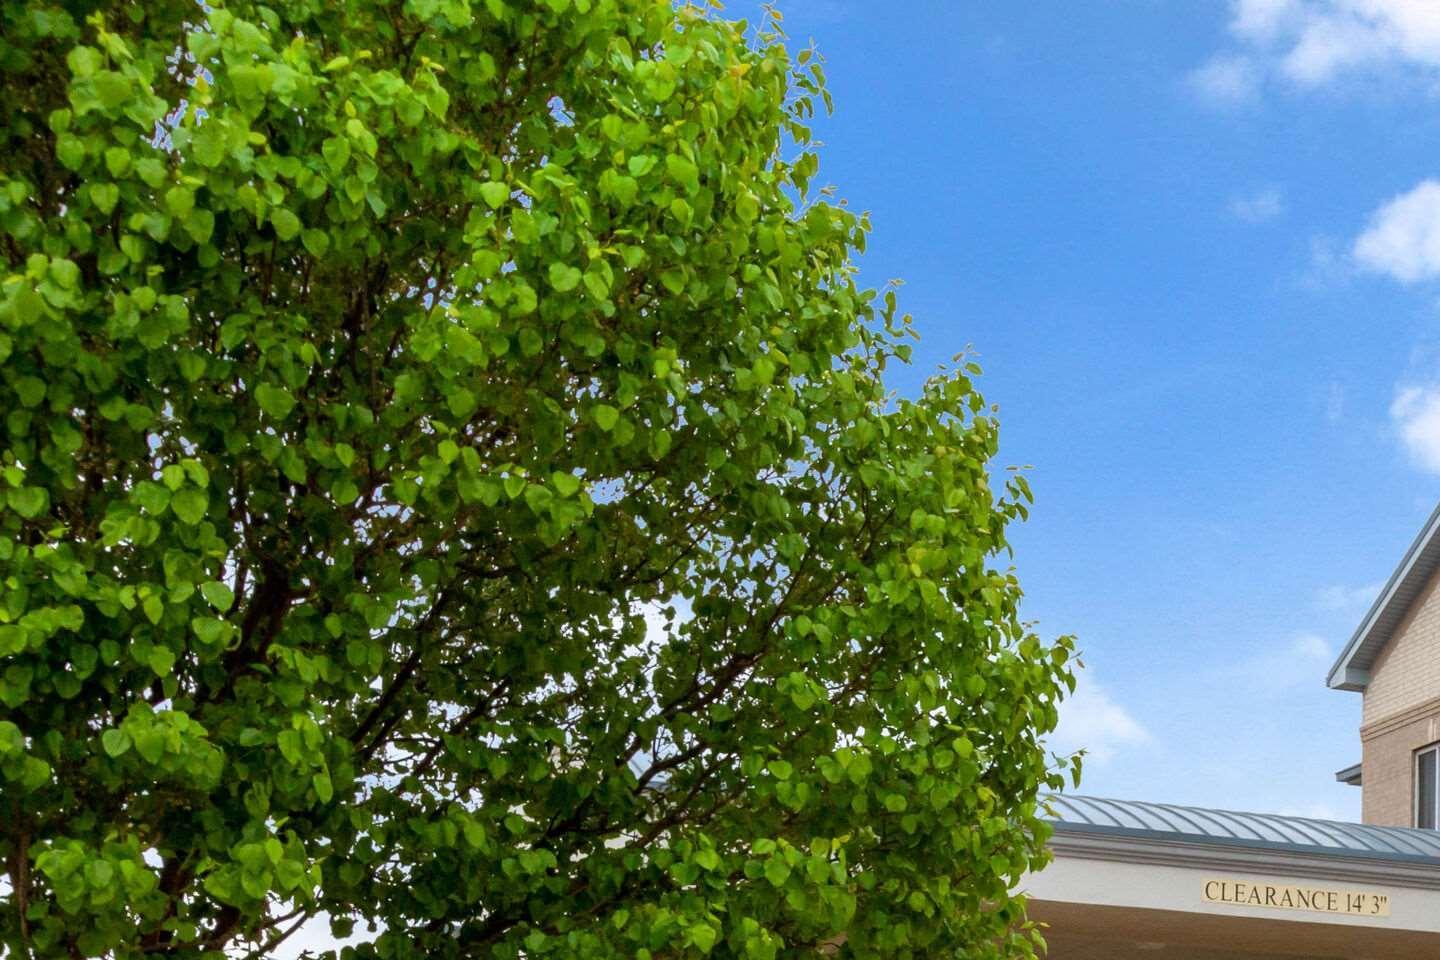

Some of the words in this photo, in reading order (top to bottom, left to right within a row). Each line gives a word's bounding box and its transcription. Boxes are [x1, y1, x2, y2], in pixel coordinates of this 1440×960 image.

[1205, 880, 1338, 911] CLEARANCE
[1347, 893, 1366, 913] 14'
[1370, 895, 1388, 914] 3"
